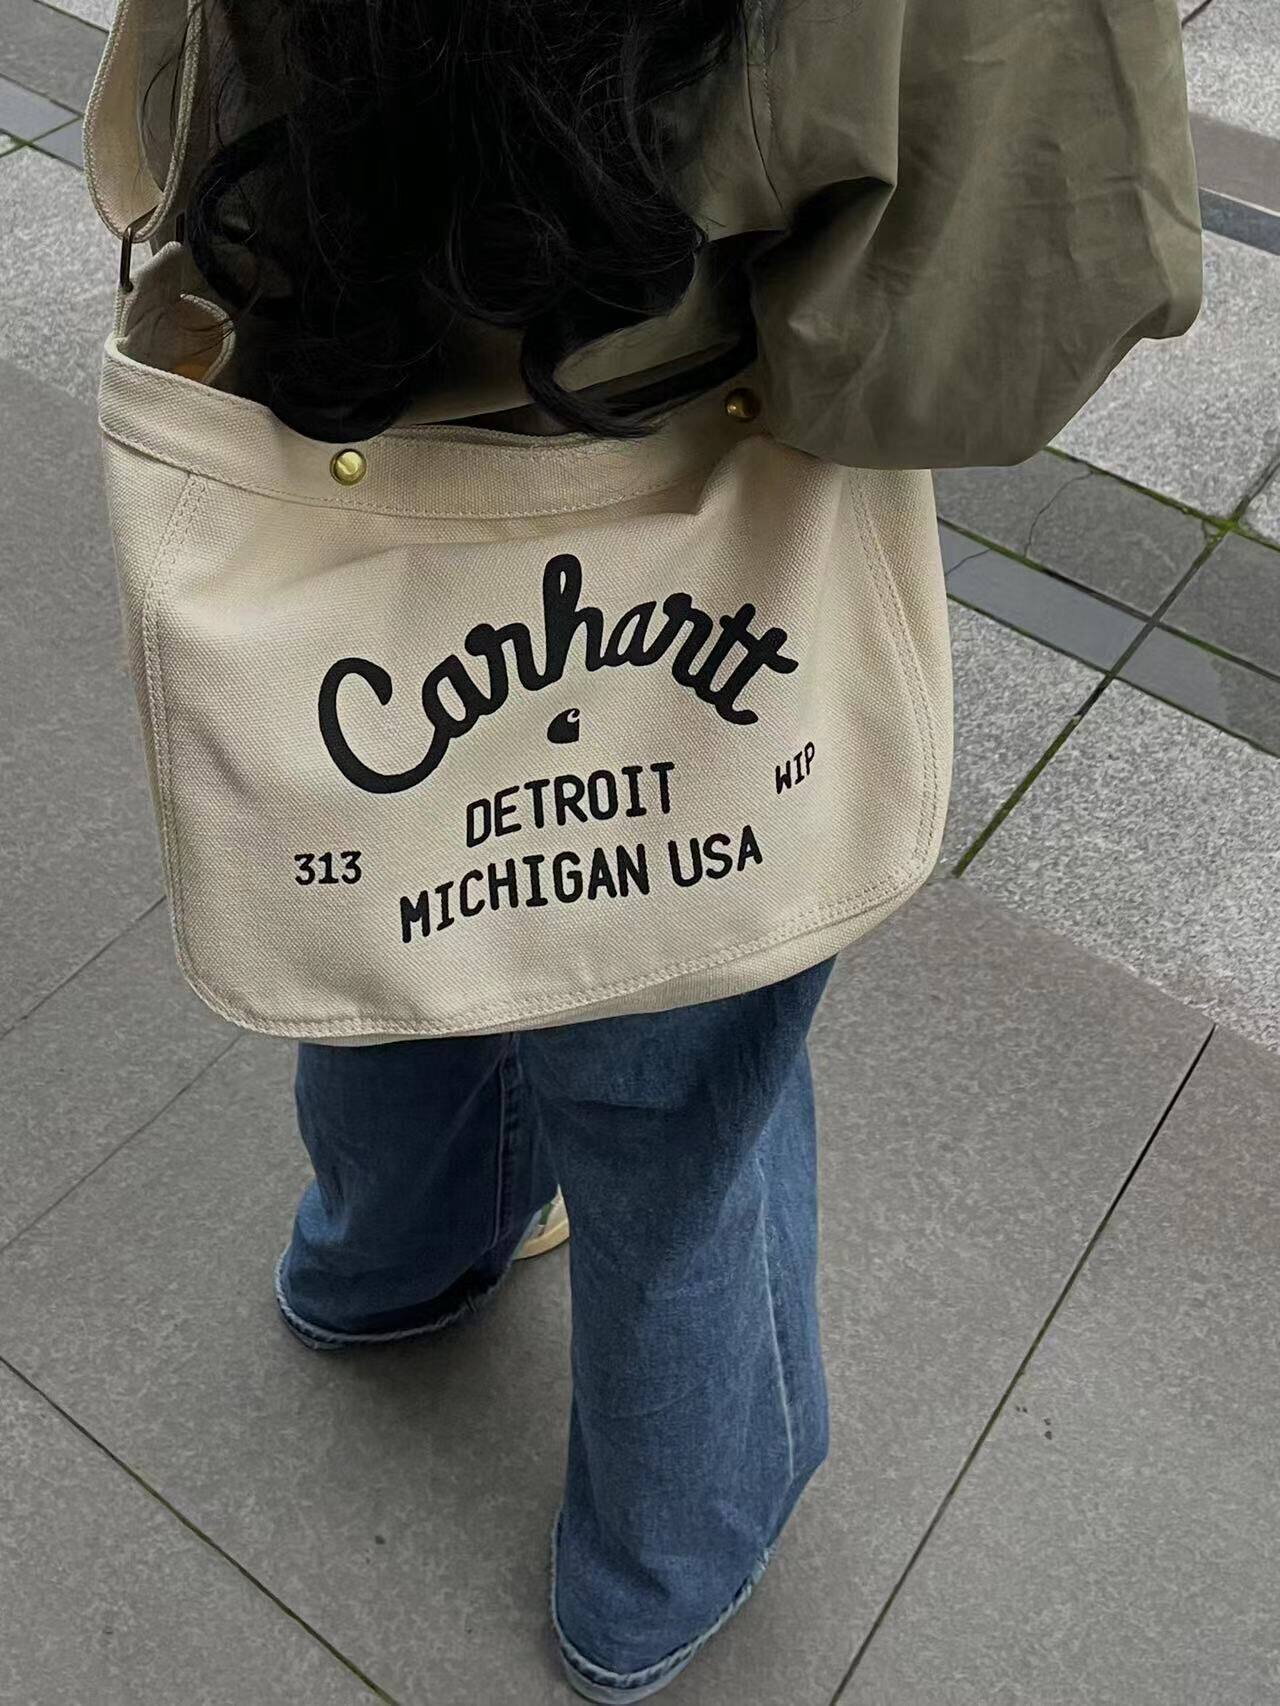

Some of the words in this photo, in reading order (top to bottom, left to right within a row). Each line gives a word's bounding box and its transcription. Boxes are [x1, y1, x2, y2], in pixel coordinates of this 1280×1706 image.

[317, 553, 799, 795] Carhartt
[466, 761, 676, 849] DETROIT
[775, 741, 815, 794] WIP
[294, 850, 362, 886] 313
[400, 843, 651, 944] MICHIGAN
[667, 824, 763, 888] USA
